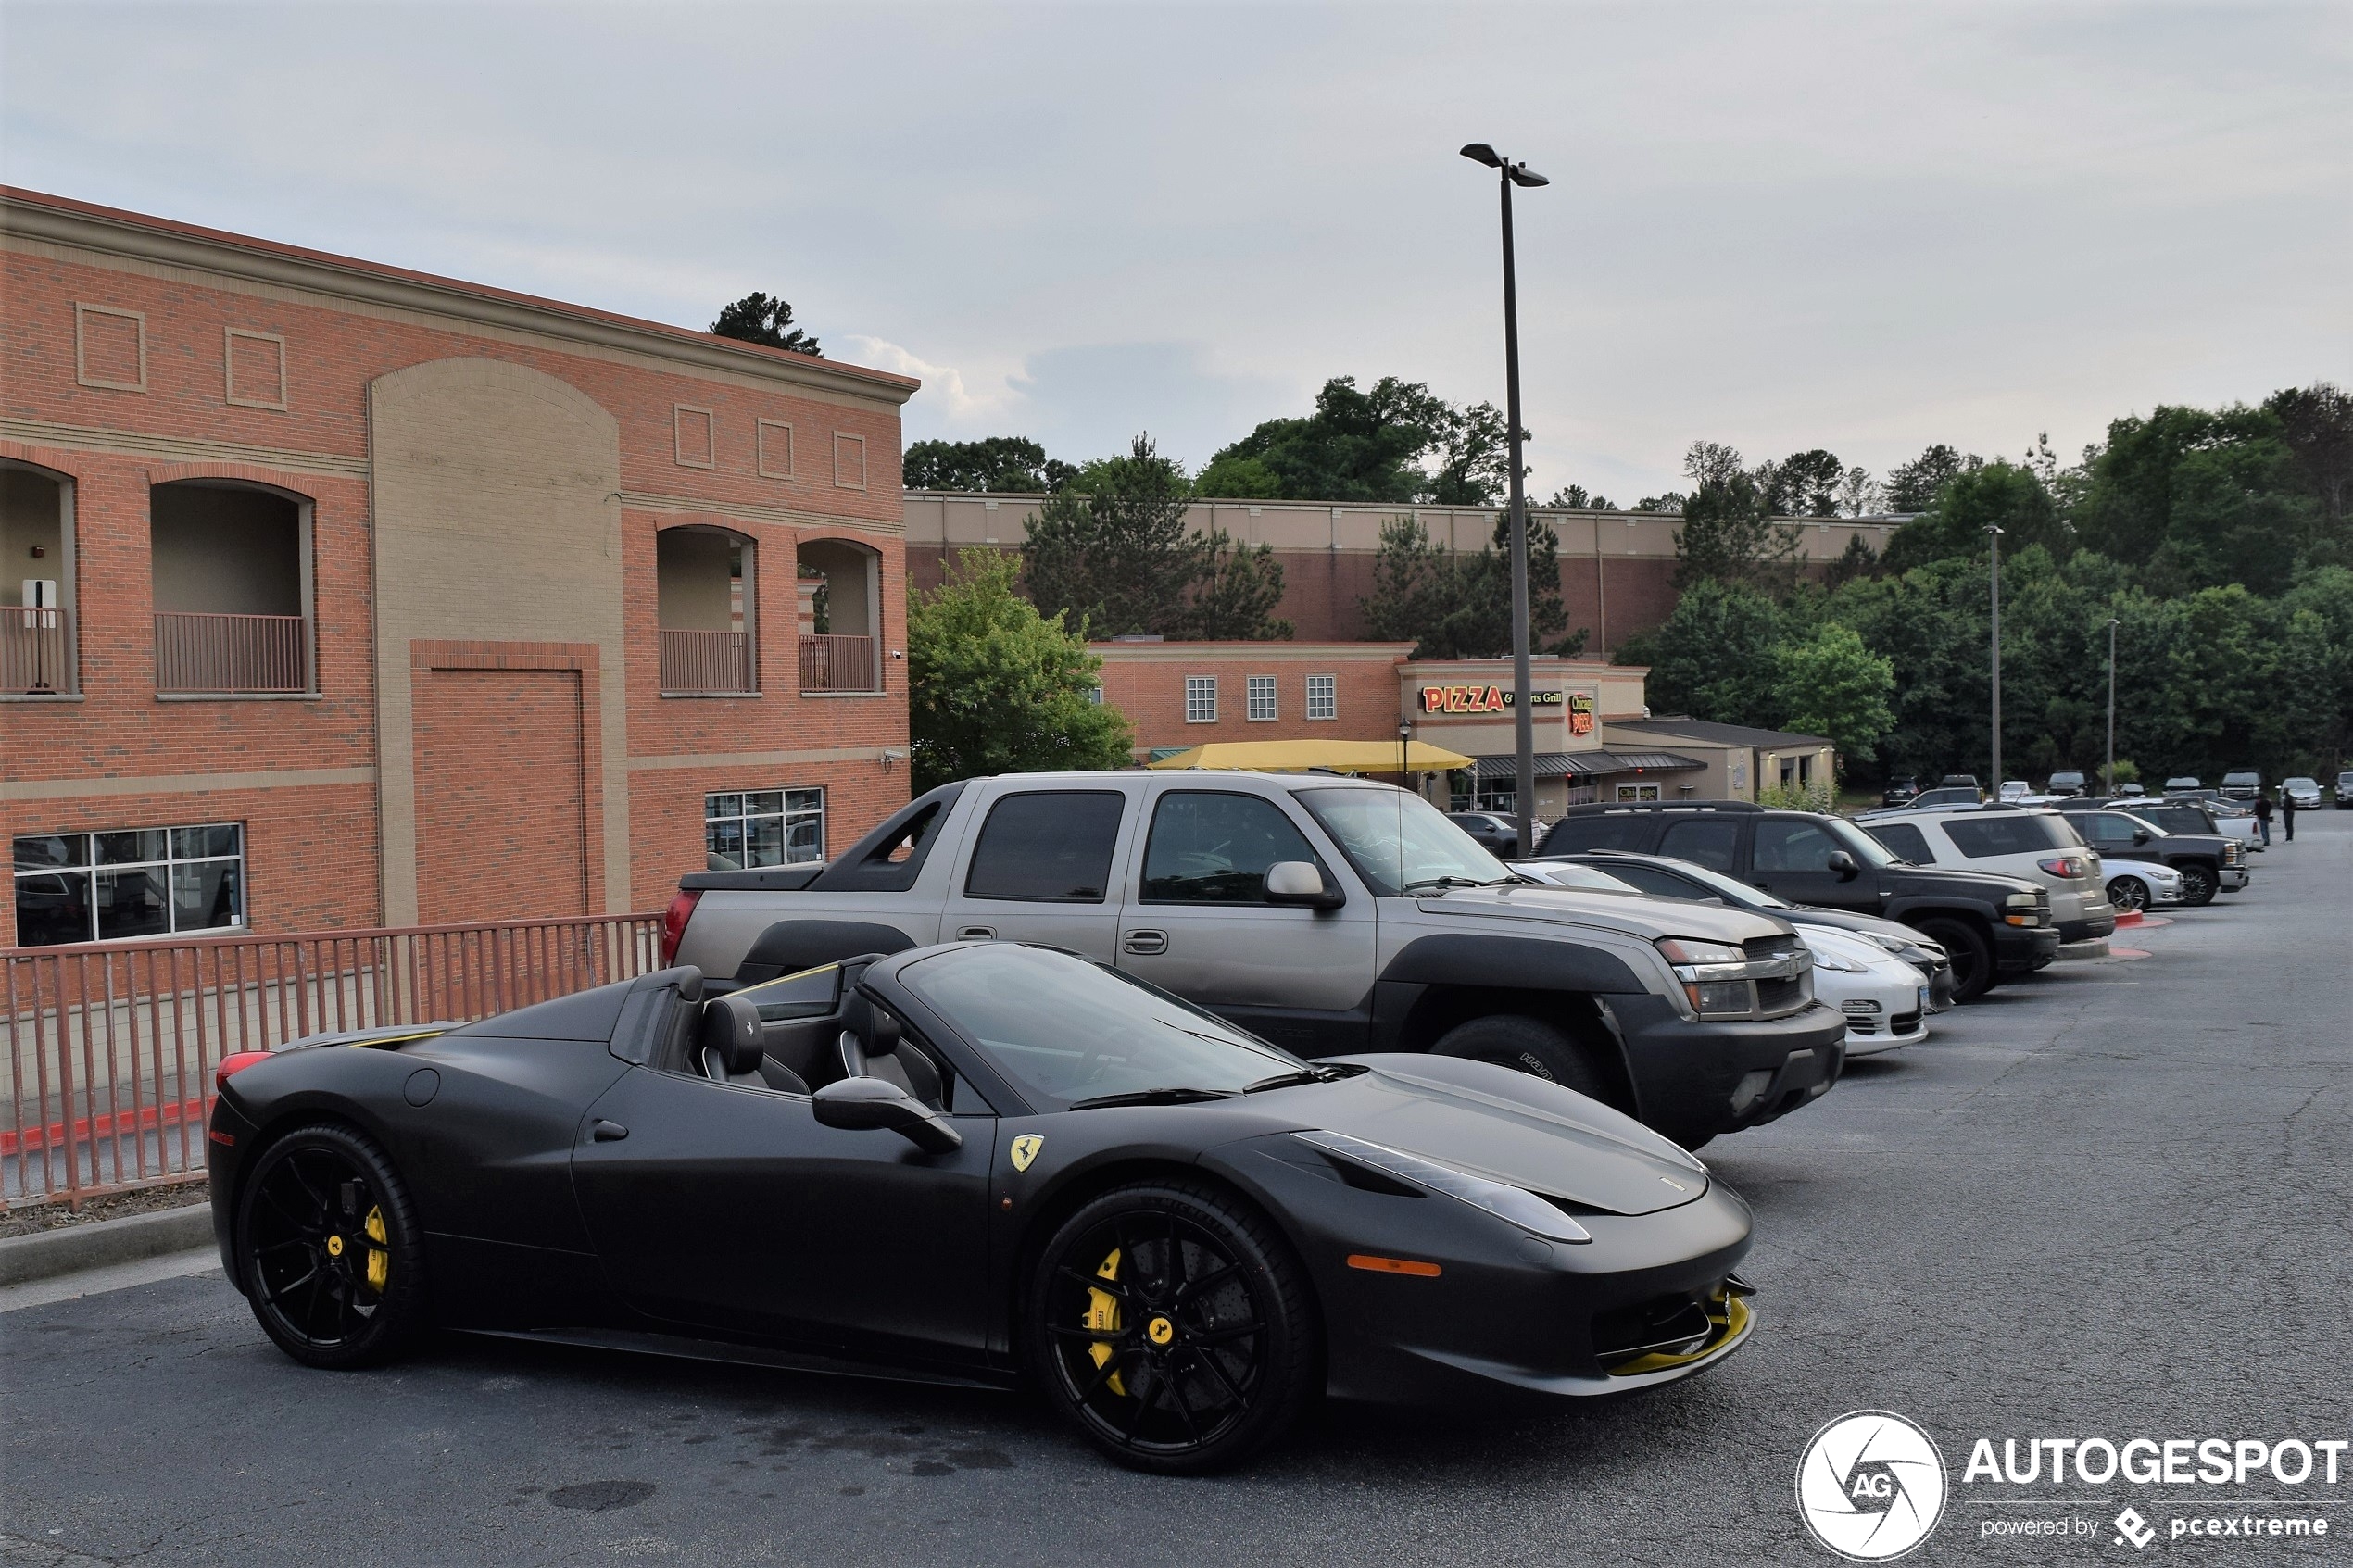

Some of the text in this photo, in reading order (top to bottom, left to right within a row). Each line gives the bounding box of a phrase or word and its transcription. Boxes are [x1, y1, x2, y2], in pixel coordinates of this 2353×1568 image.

[1423, 686, 1561, 712] PIZZA & rts Grill
[1572, 696, 1593, 712] Chicago
[1572, 713, 1594, 733] PIZZA
[1619, 788, 1656, 797] Chiago
[1519, 1052, 1555, 1083] Han
